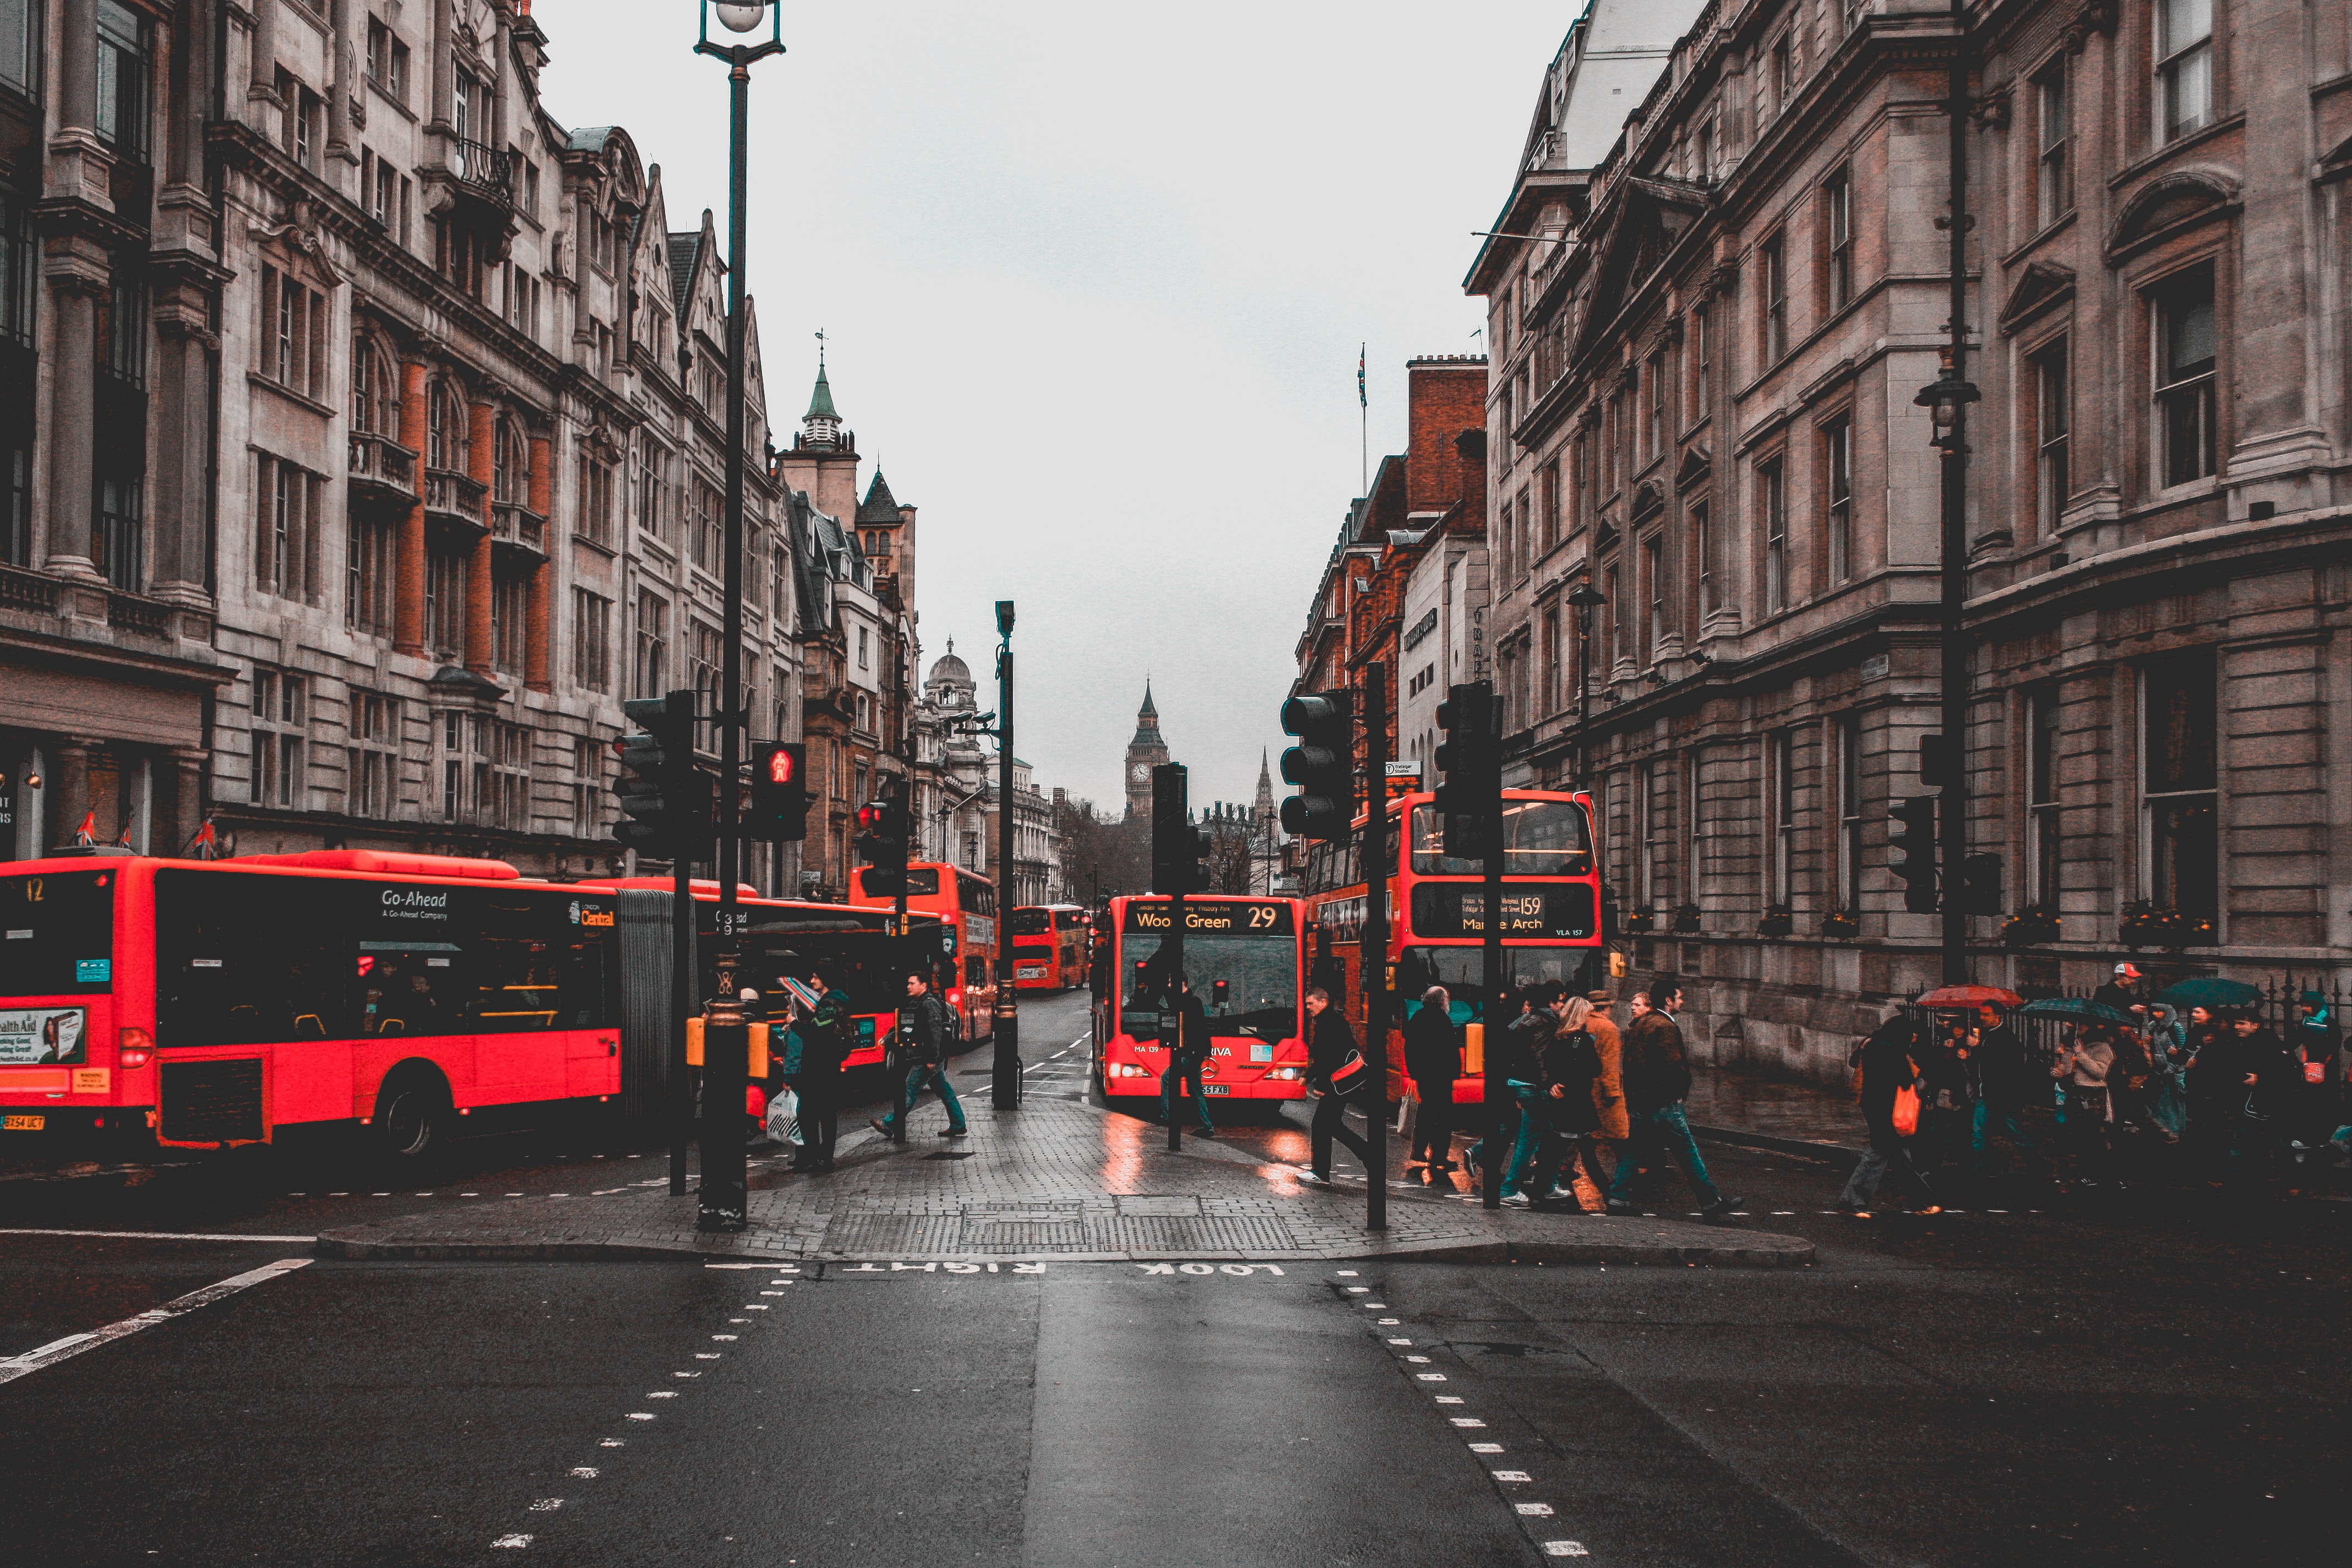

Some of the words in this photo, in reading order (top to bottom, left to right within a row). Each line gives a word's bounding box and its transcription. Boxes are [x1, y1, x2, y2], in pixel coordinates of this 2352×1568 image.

[27, 878, 44, 902] 12
[382, 890, 447, 907] Go-Ahead
[1521, 897, 1541, 915] 159
[389, 910, 418, 918] Go-Ahead
[420, 911, 448, 921] Company
[581, 910, 614, 926] Central
[725, 914, 732, 924] 3
[1136, 912, 1172, 928] Woo
[1185, 913, 1231, 928] Green
[1248, 906, 1277, 928] 29
[724, 925, 732, 935] 9
[1512, 918, 1543, 929] Arch
[1212, 1086, 1228, 1094] FXB
[841, 1262, 1046, 1275] RIGHT
[1136, 1263, 1285, 1277] LOOK
